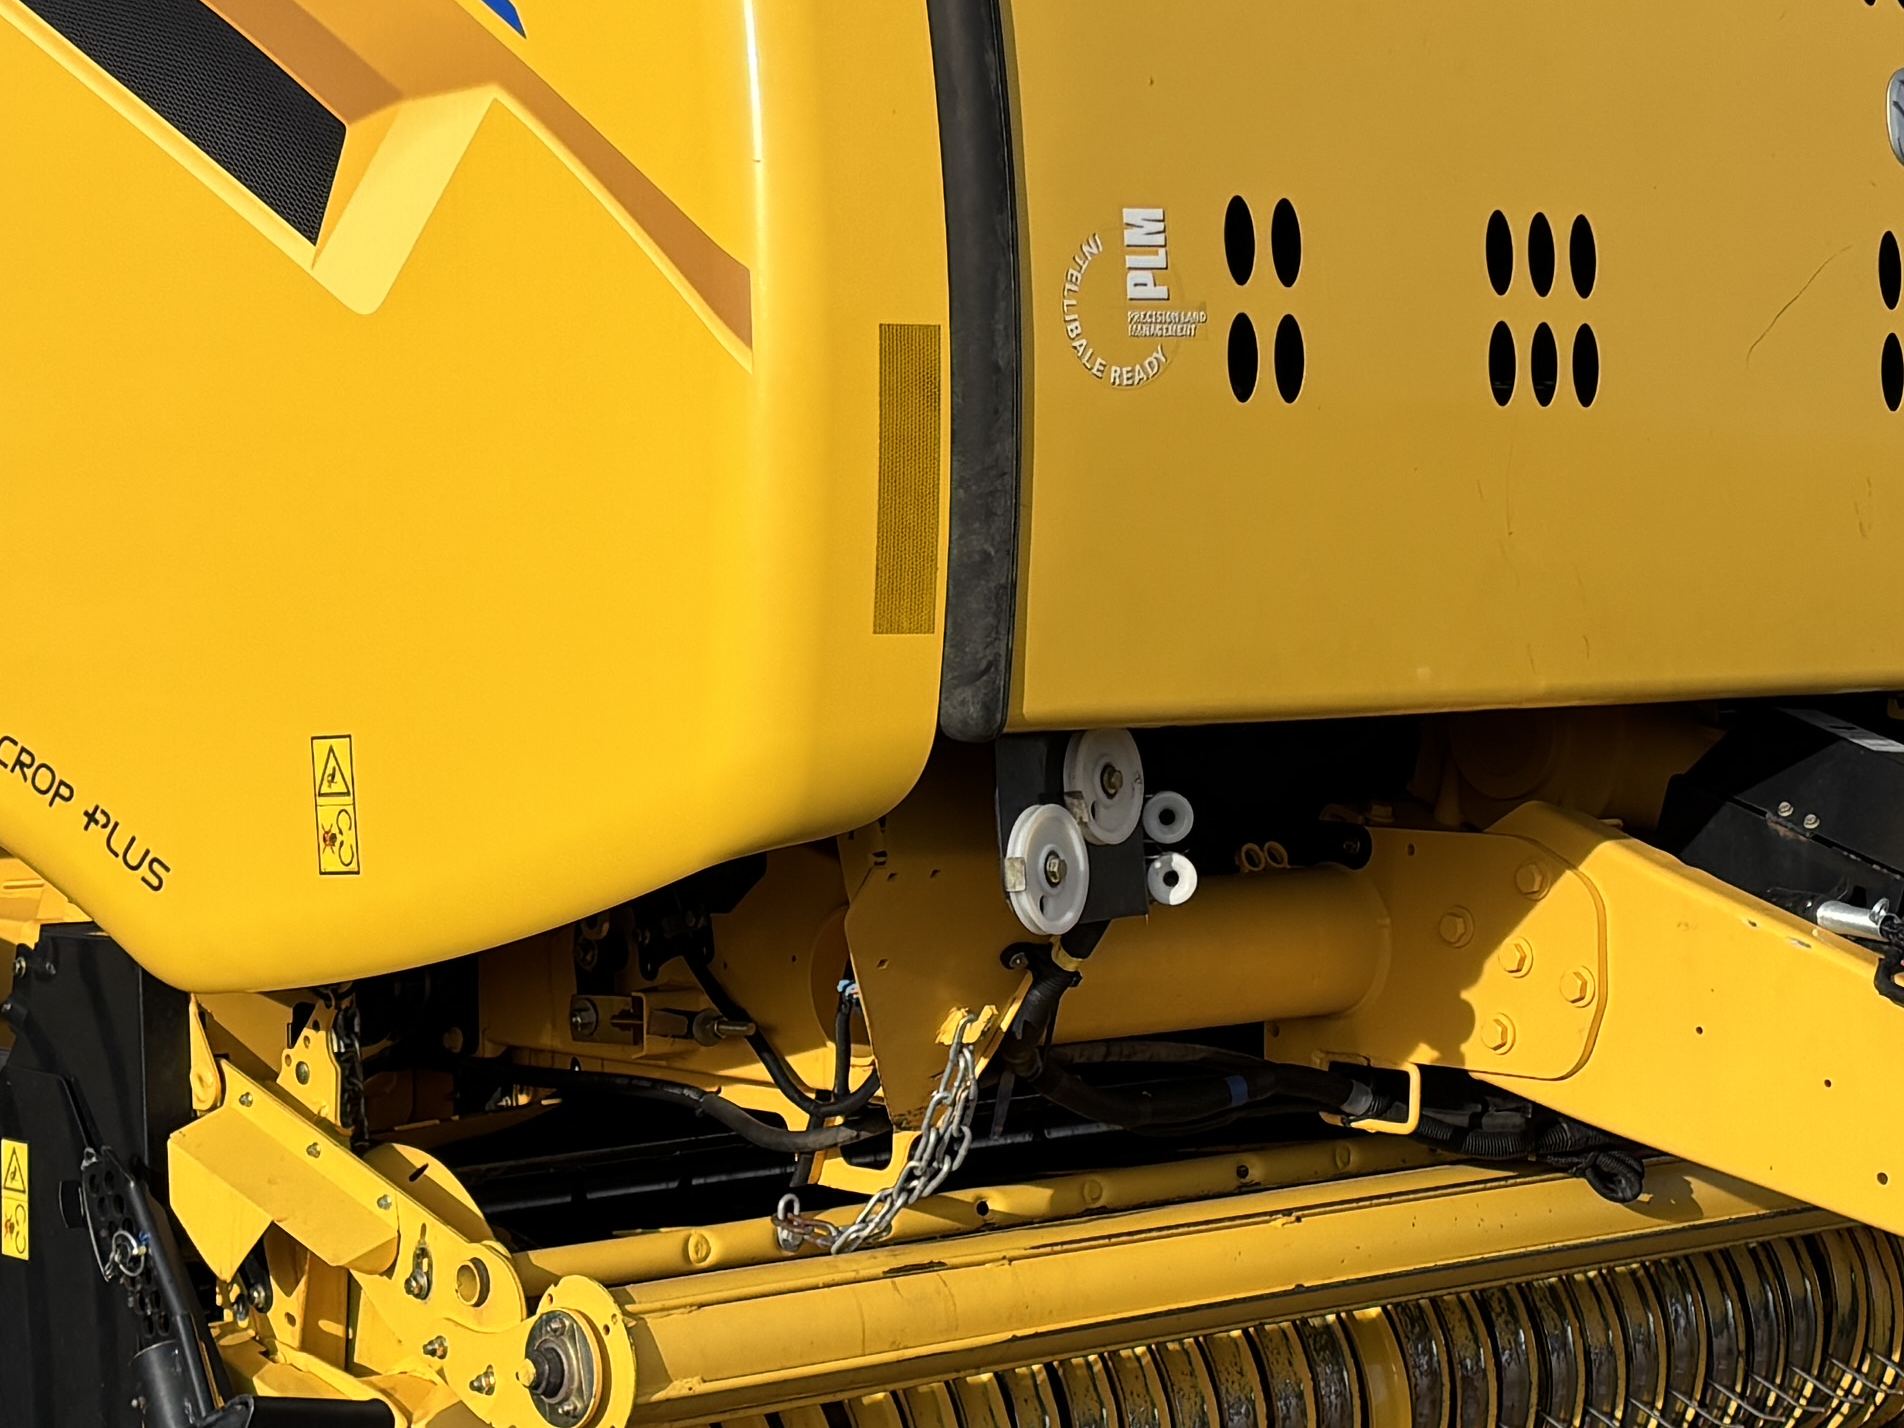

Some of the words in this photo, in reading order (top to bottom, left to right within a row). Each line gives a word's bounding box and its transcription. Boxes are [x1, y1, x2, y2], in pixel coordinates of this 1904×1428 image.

[1062, 233, 1106, 380] INTELLIBALE
[1110, 344, 1168, 387] READY
[1123, 208, 1170, 300] PLM
